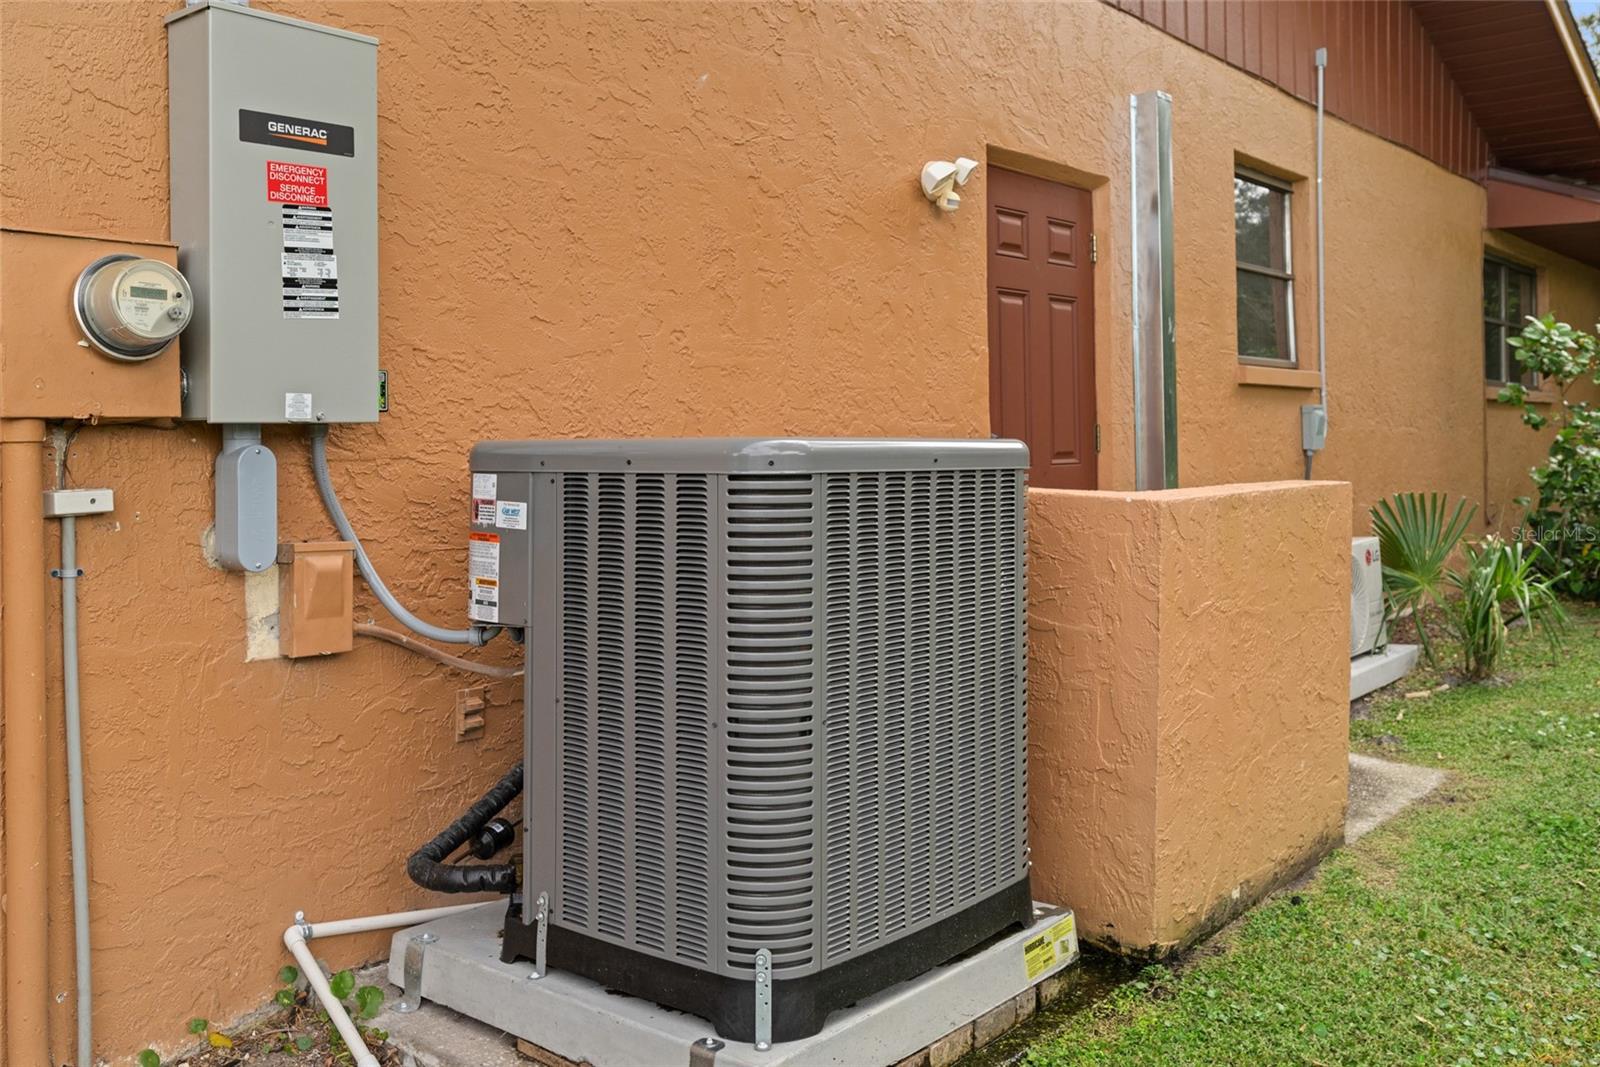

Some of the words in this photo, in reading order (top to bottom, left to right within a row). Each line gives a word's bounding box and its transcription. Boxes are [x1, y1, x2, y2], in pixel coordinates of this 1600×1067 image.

[267, 121, 328, 139] GENERAC
[270, 163, 324, 177] EMERGENCY
[269, 172, 325, 185] DISCONNECT
[279, 183, 316, 195] SERVICE
[270, 191, 326, 204] DISCONNECT
